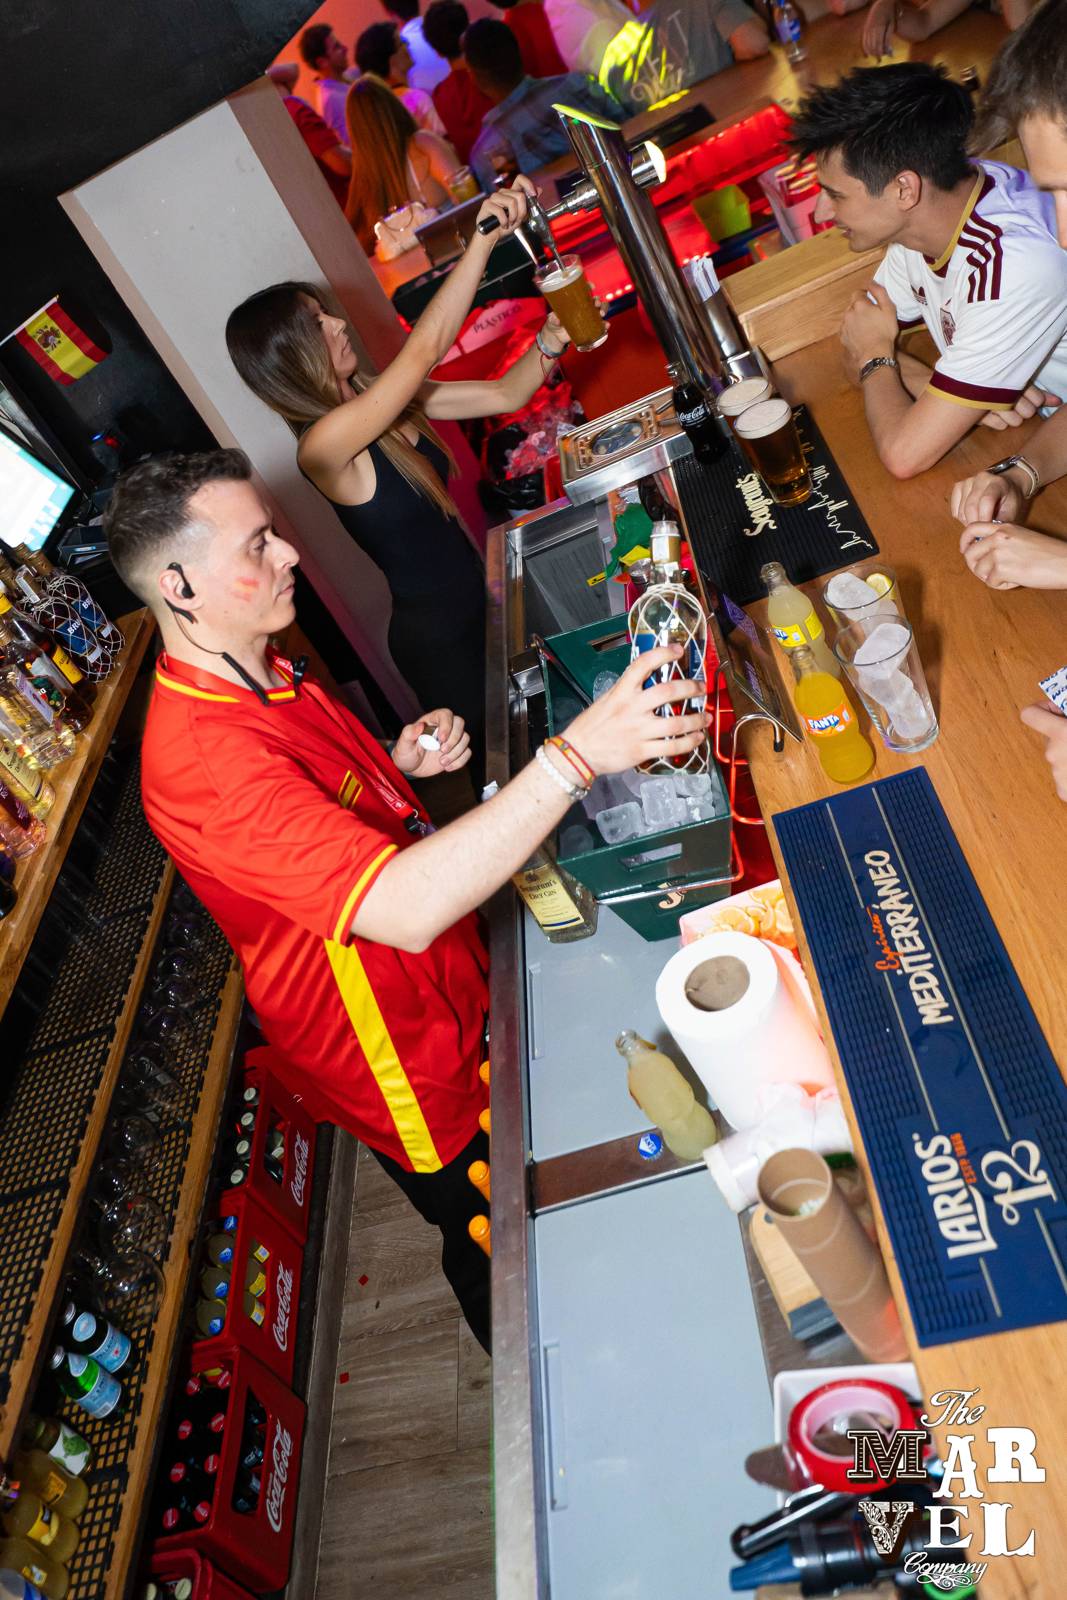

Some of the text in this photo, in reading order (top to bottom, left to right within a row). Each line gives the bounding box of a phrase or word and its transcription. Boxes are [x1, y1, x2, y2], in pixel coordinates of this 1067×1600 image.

[808, 714, 840, 731] FANTA
[864, 850, 954, 1025] MEDITERRÁNEO
[291, 1130, 308, 1207] Coca-Cola
[981, 1140, 1057, 1225] 12
[272, 1260, 293, 1352] Coca-Cola
[266, 1418, 293, 1533] Coca-Cola
